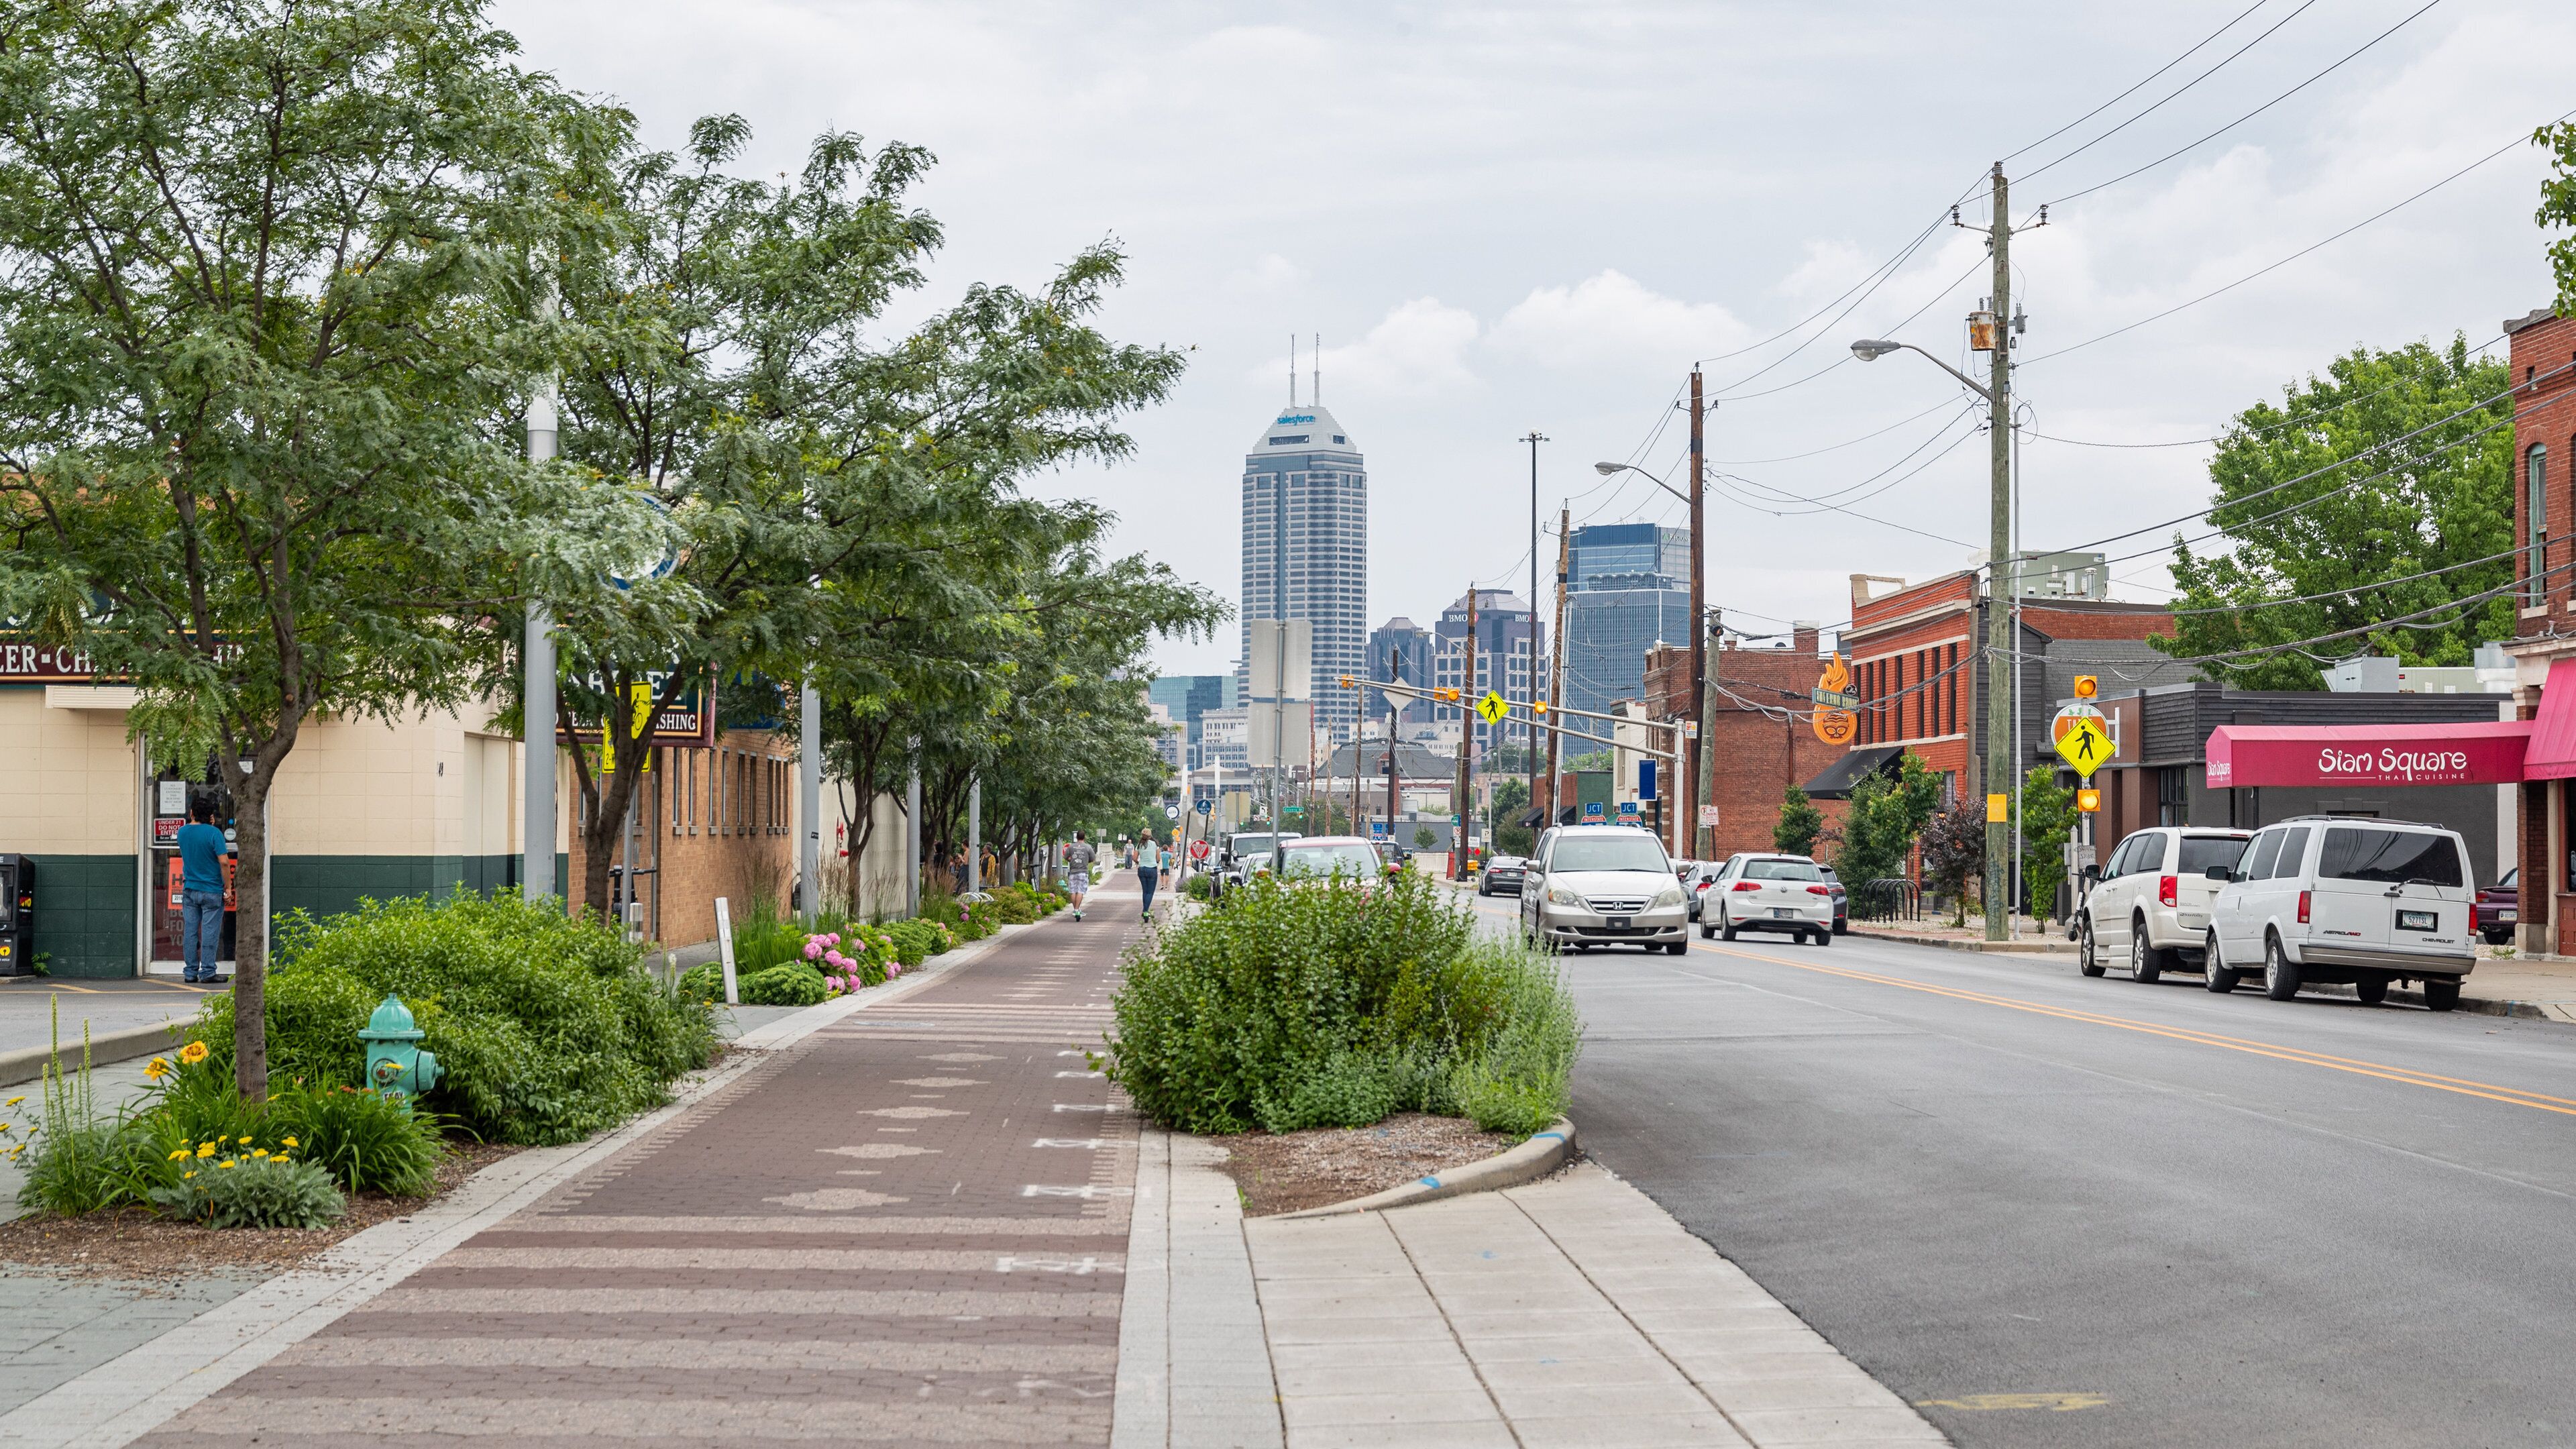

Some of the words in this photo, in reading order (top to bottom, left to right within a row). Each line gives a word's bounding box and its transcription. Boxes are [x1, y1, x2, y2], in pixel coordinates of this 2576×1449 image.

[1277, 415, 1315, 426] salesforce
[1449, 614, 1468, 623] BMO
[1515, 614, 1529, 623] BMO
[2318, 748, 2372, 773] Siam
[2379, 748, 2467, 781] Square
[2408, 916, 2426, 924] 527TSL
[170, 920, 184, 932] FO
[170, 934, 183, 947] YO
